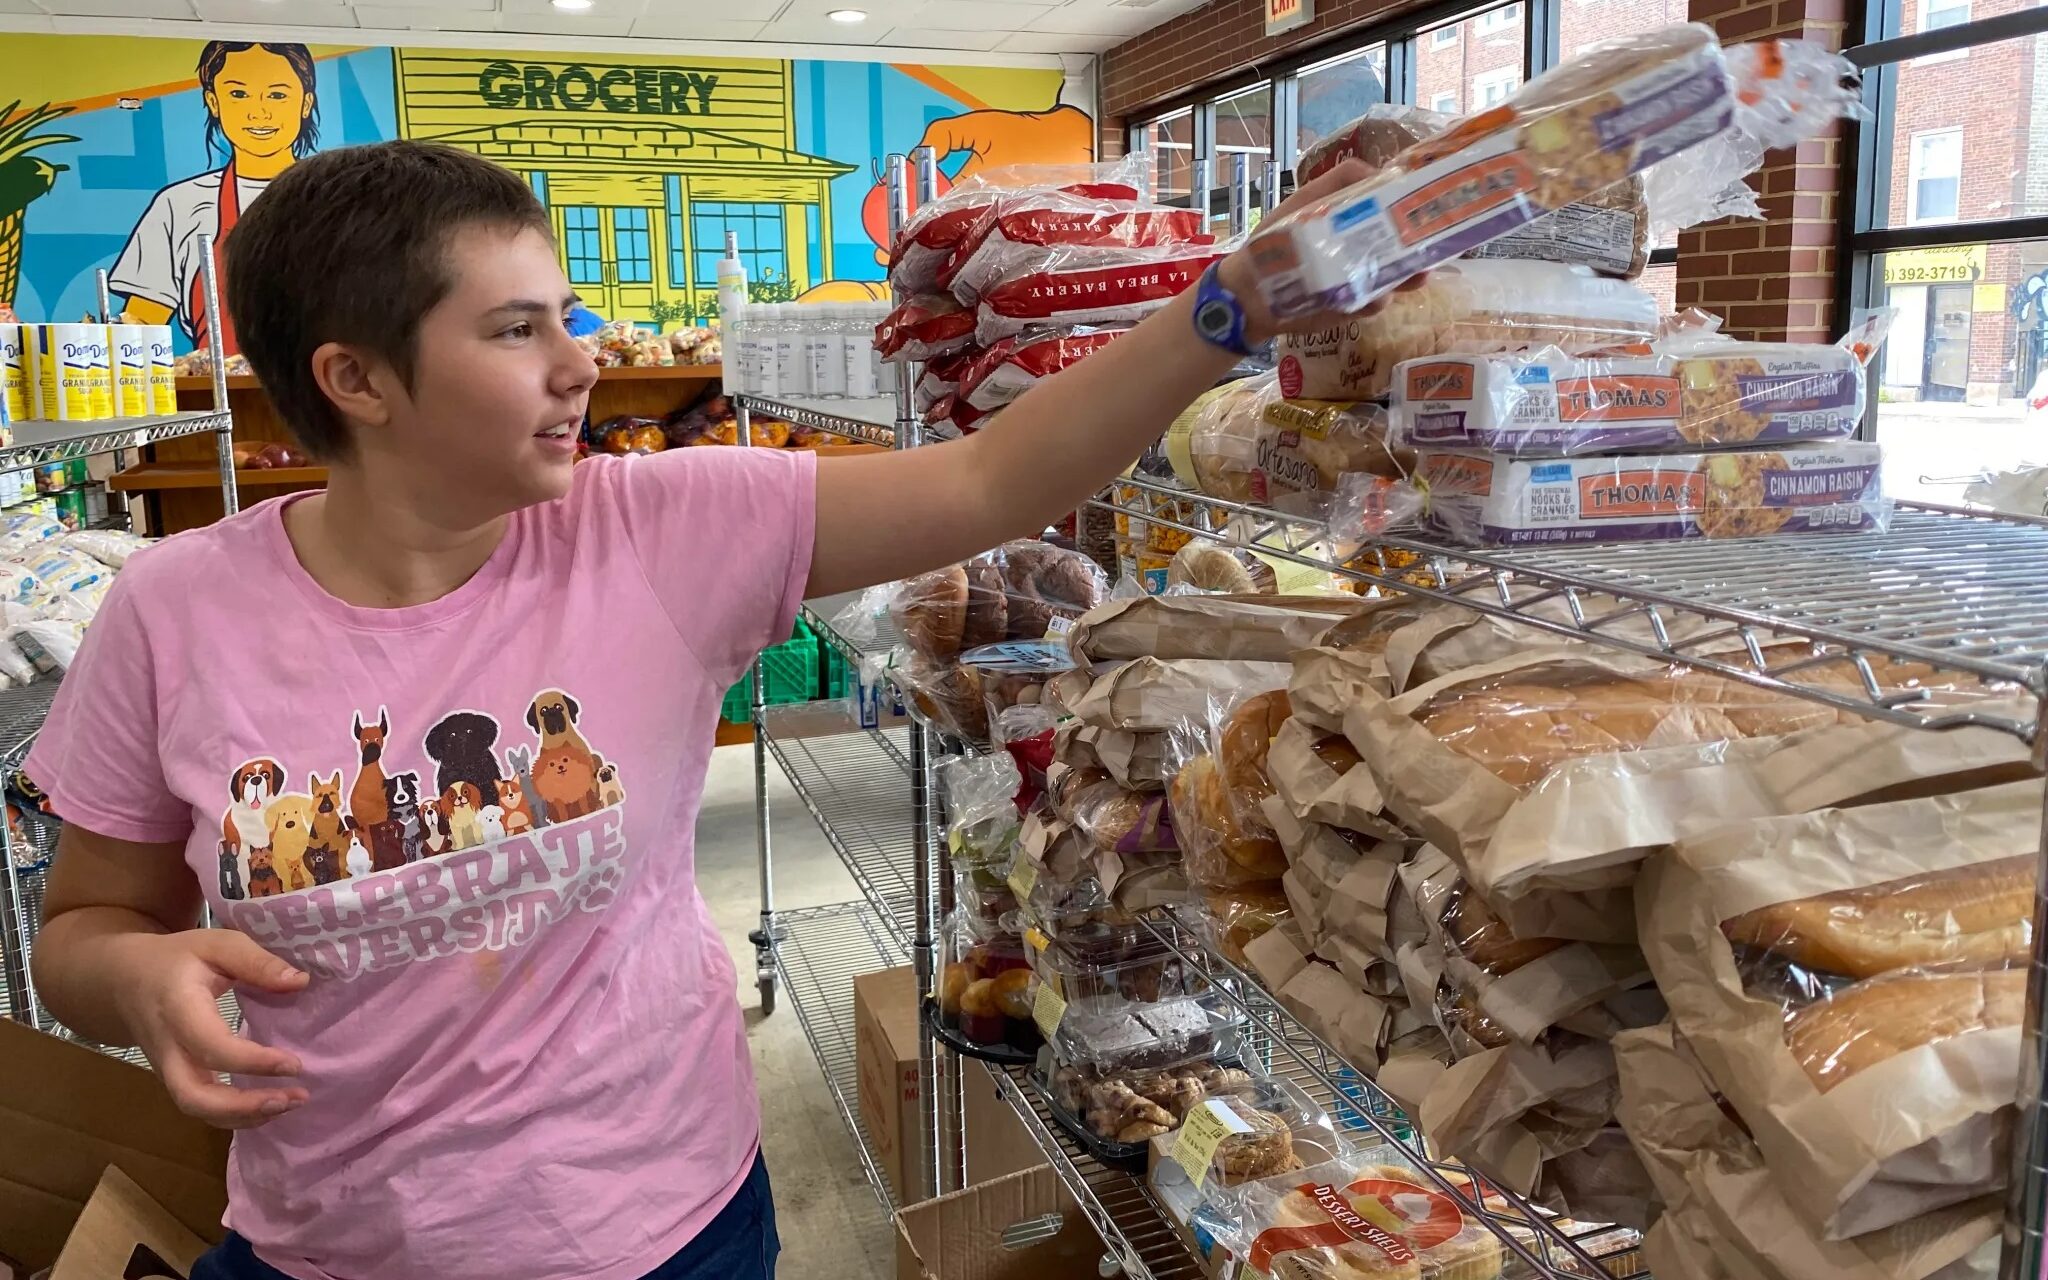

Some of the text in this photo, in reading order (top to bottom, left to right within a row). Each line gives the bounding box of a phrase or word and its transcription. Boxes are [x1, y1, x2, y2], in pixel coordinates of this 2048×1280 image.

[479, 61, 719, 116] GROCERY
[1168, 271, 1188, 283] LA
[1899, 265, 1967, 281] 392-3719
[1117, 274, 1159, 290] BREA
[1058, 345, 1104, 358] ERY
[1767, 361, 1792, 374] English
[1746, 376, 1839, 402] CINNAMON RAISIN
[1770, 470, 1864, 496] CINNAMON RAISIN
[1531, 493, 1560, 506] NOOKS
[1530, 504, 1576, 517] CRANNIES
[233, 809, 622, 945] CELEBRATE
[1313, 1185, 1413, 1262] DESSERT SHELLS
